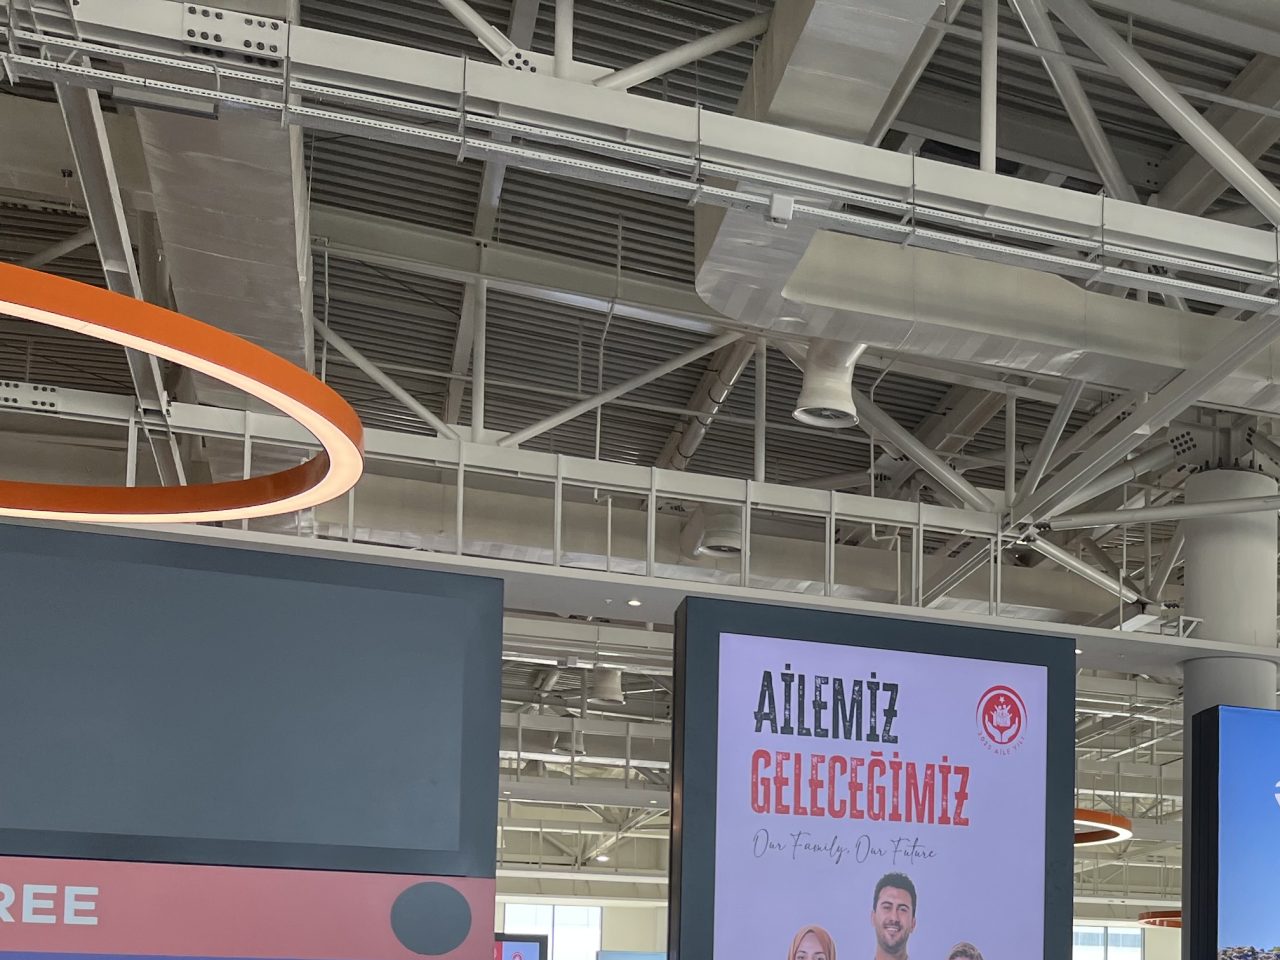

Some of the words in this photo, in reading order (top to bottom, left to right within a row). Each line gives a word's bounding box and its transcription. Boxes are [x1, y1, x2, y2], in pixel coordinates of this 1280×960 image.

[754, 663, 899, 744] AİLEMİZ
[751, 749, 970, 827] GELECEĞİMİZ
[752, 828, 786, 858] Our
[855, 834, 886, 864] Our
[891, 837, 936, 865] Future
